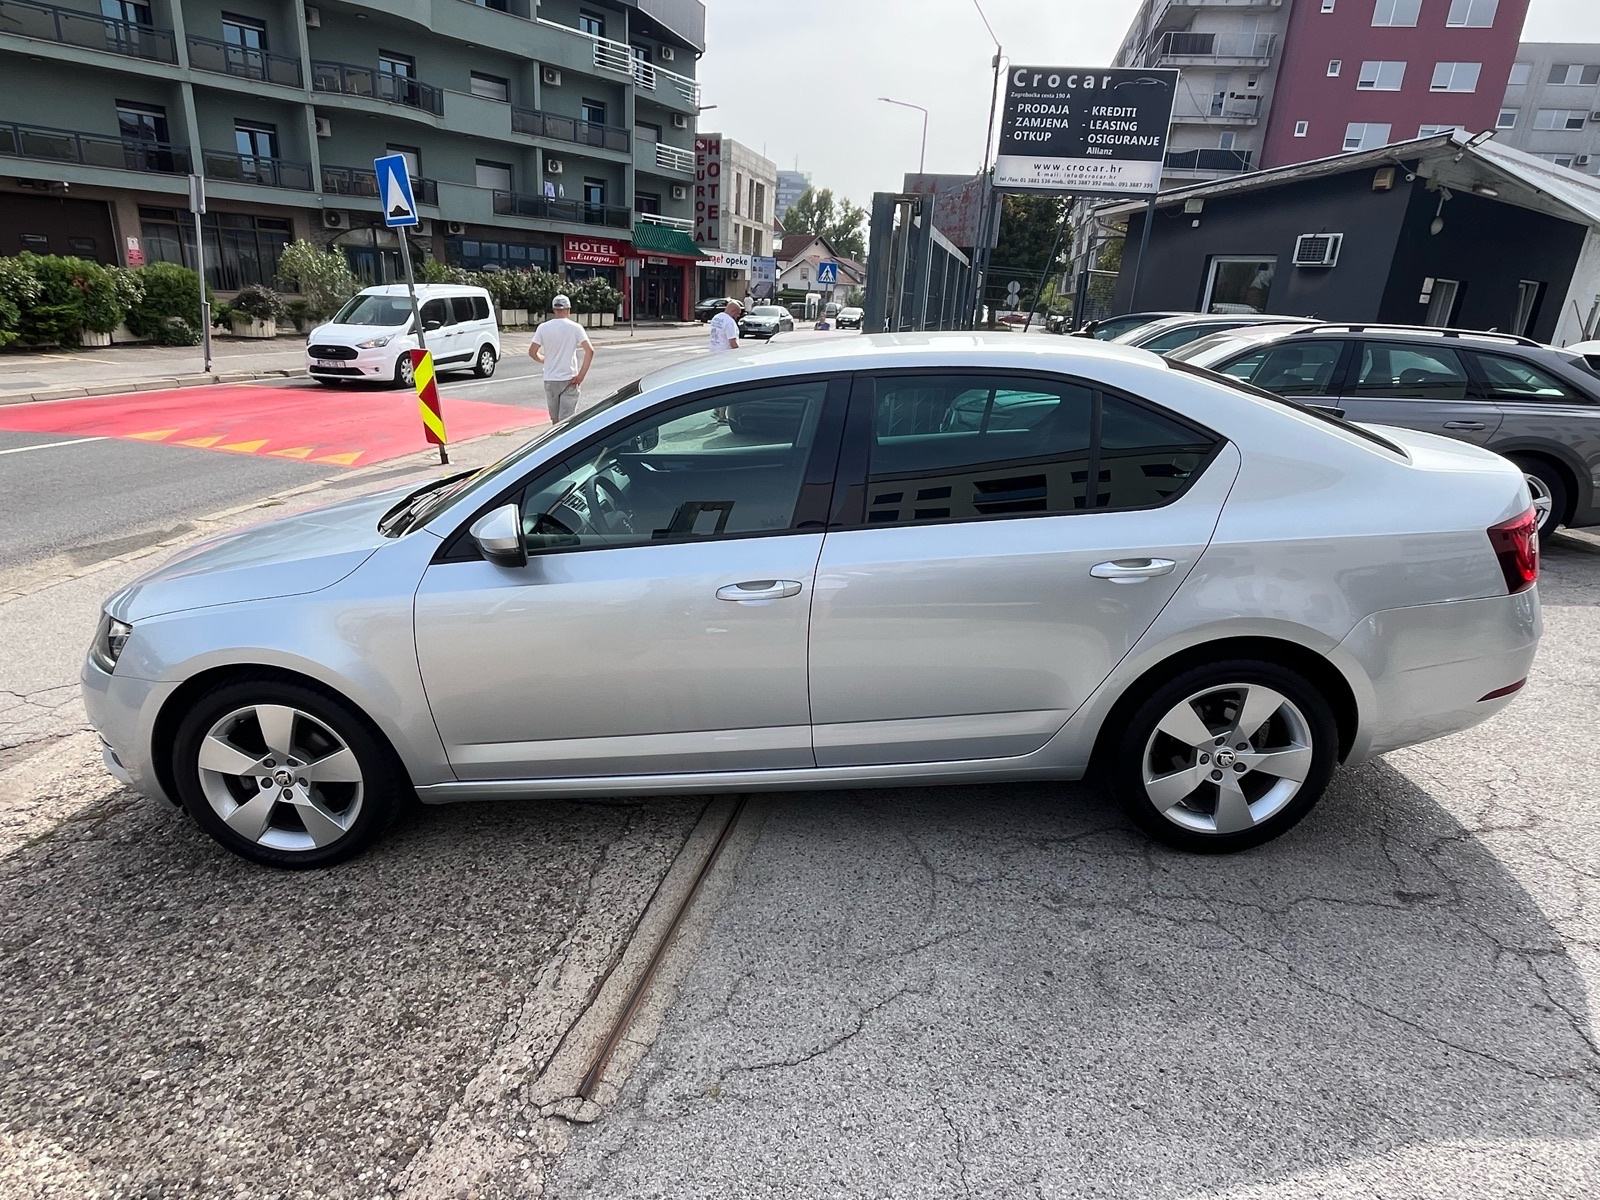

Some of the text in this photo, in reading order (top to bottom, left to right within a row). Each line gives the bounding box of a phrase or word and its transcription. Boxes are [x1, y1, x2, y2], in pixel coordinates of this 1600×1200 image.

[1013, 68, 1112, 90] Crocar
[1017, 103, 1070, 114] PRODAJA
[1091, 106, 1138, 118] KREDITI
[1015, 117, 1069, 129] ZAMJENA
[1089, 120, 1138, 132] LEASING
[1014, 130, 1052, 142] OTKUP
[1087, 134, 1160, 146] OSIGURANJE
[1086, 146, 1113, 156] Allianz
[1033, 164, 1123, 173] www.crocar.hr
[707, 139, 720, 241] HOTEL
[695, 154, 705, 242] EUROPA
[568, 241, 617, 254] HOTEL
[726, 256, 748, 266] opeke
